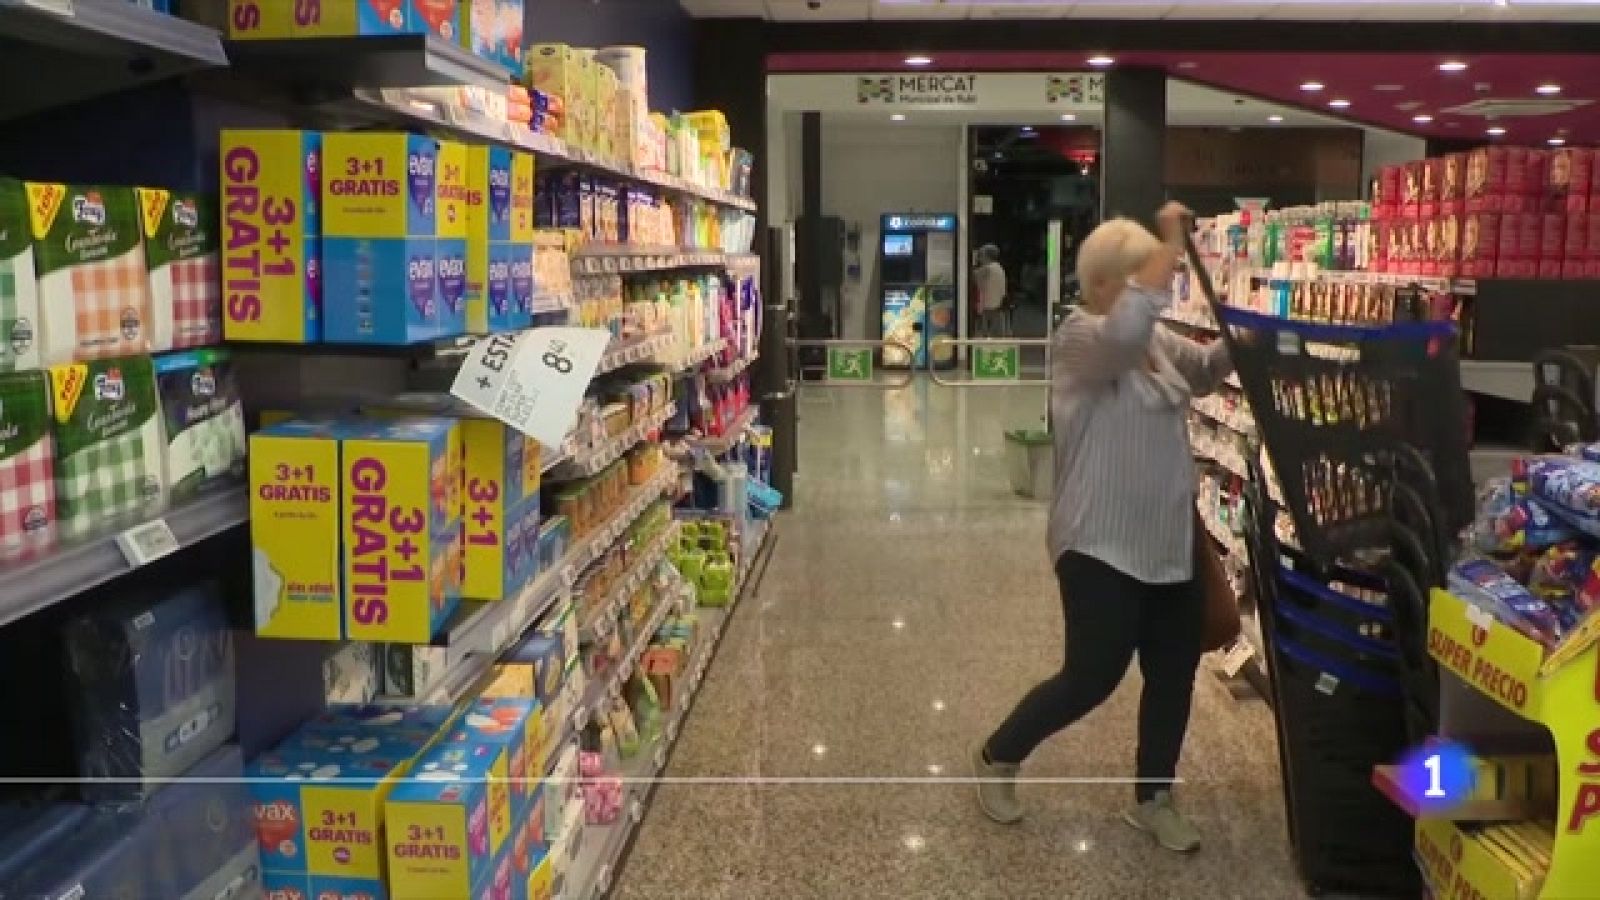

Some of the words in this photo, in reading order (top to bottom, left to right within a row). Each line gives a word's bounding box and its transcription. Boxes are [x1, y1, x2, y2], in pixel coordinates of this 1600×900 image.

[899, 75, 976, 92] MERCAT
[346, 157, 384, 176] 3+1
[329, 179, 400, 197] GRATIS
[224, 146, 261, 323] GRATIS
[262, 196, 296, 276] 3+1
[275, 463, 314, 482] 3+1
[259, 484, 331, 503] GRATIS
[467, 477, 499, 546] 3+1
[351, 457, 388, 625] GRATIS
[389, 505, 426, 582] 3+1
[1430, 626, 1472, 676] SUPER
[1473, 656, 1527, 708] PRECIO
[321, 809, 357, 827] 3+1
[309, 826, 373, 846] GRATIS
[407, 824, 445, 842] 3+1
[393, 843, 461, 861] GRATIS
